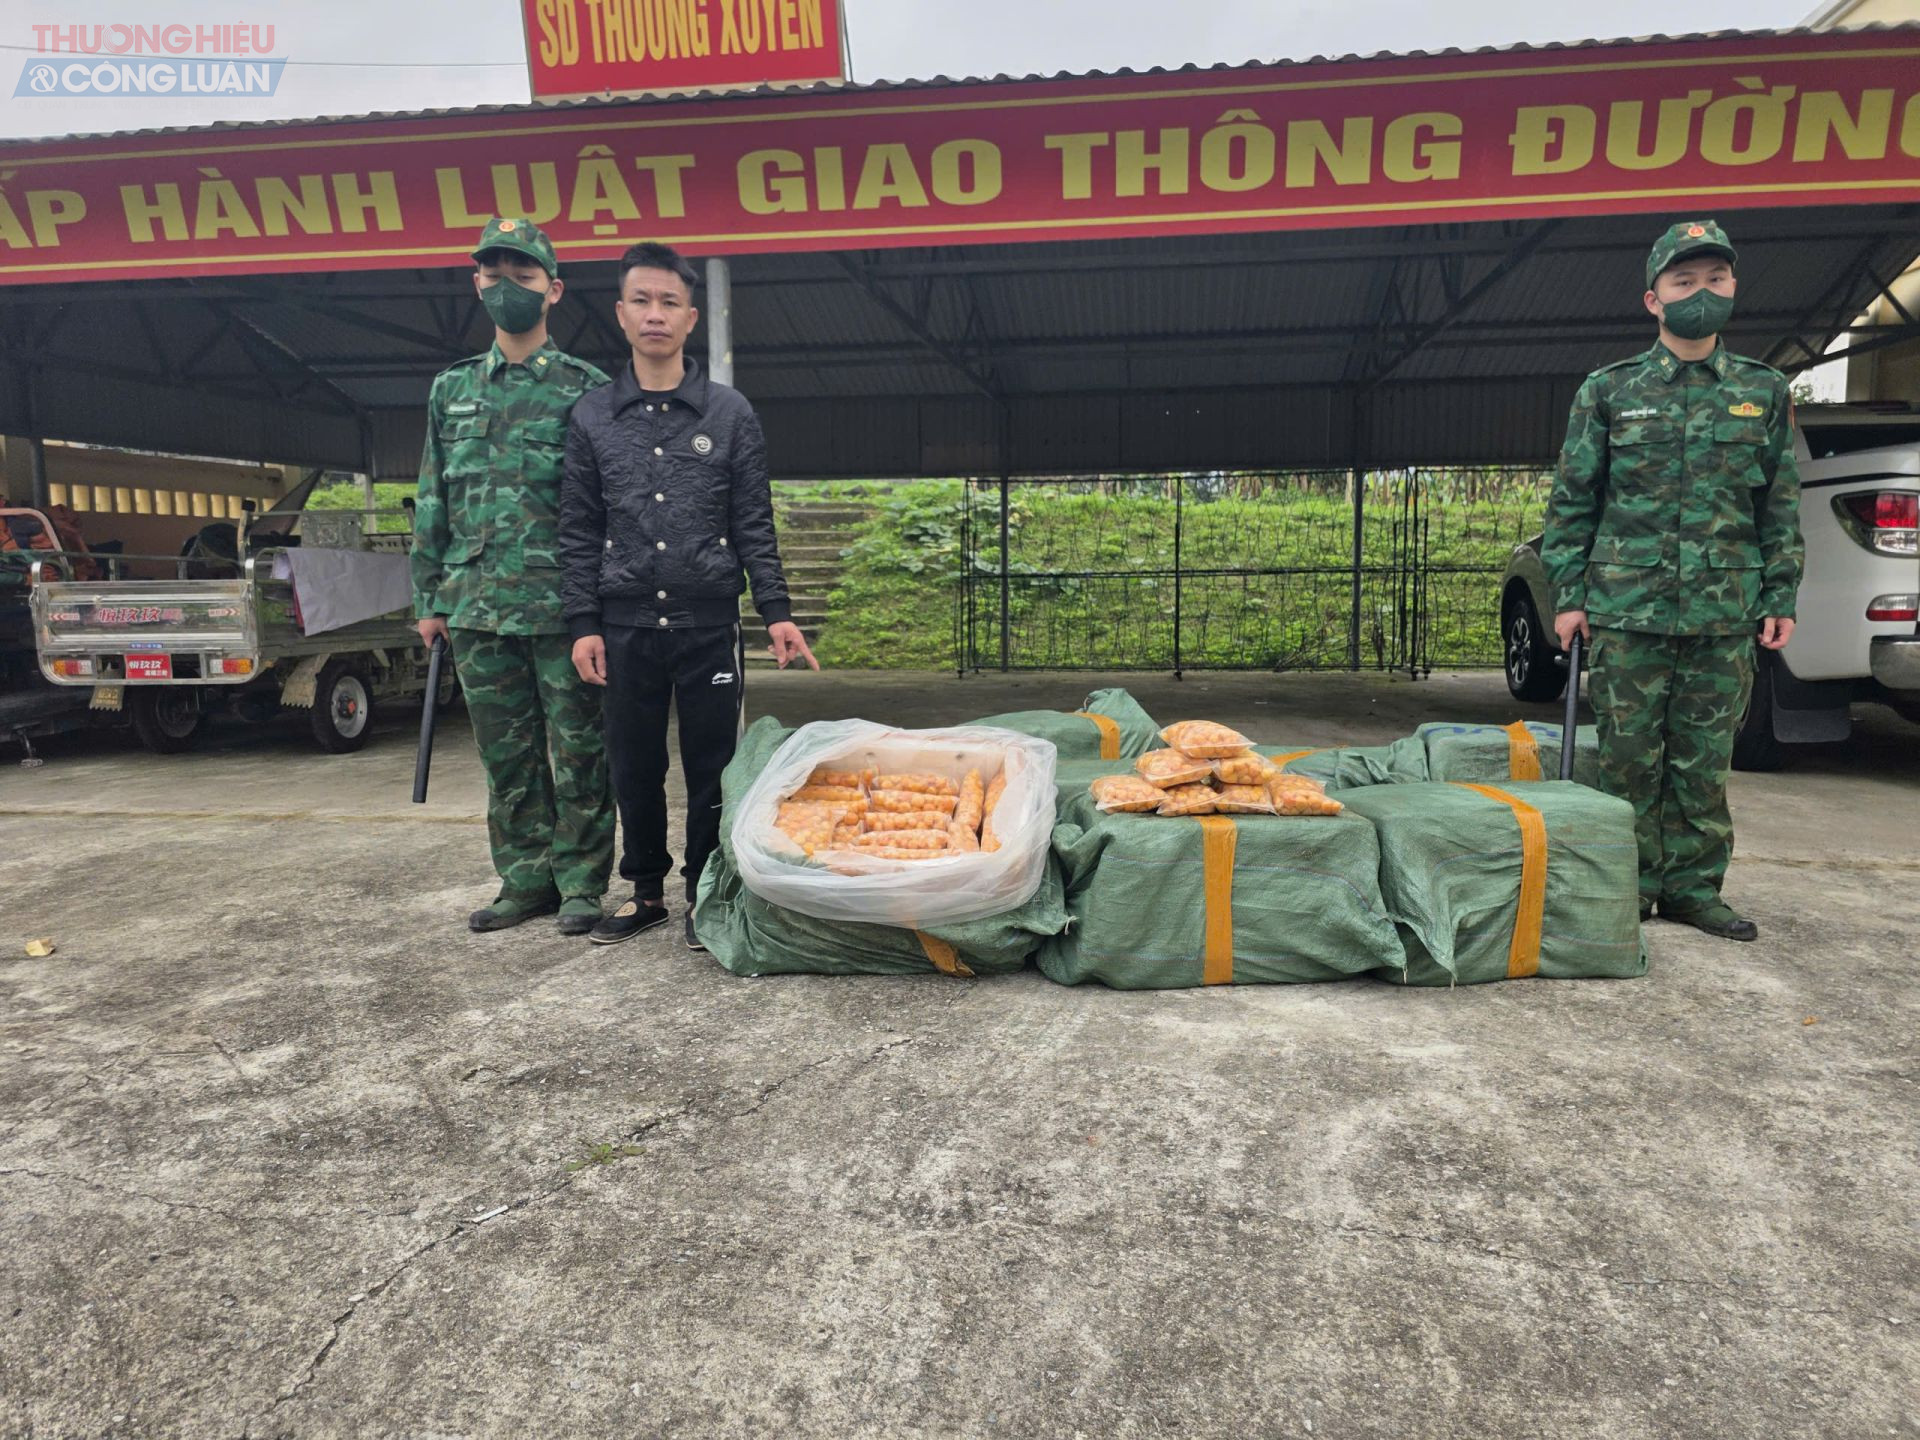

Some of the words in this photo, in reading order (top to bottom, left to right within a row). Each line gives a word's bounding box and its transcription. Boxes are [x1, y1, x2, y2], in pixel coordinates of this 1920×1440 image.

[536, 0, 580, 67] SD
[120, 167, 404, 243] HÀNH
[435, 145, 695, 235] LUẬT
[736, 138, 1002, 213] GIAO
[1044, 108, 1463, 200] THÔNG
[1508, 76, 1920, 176] ĐƯỜN
